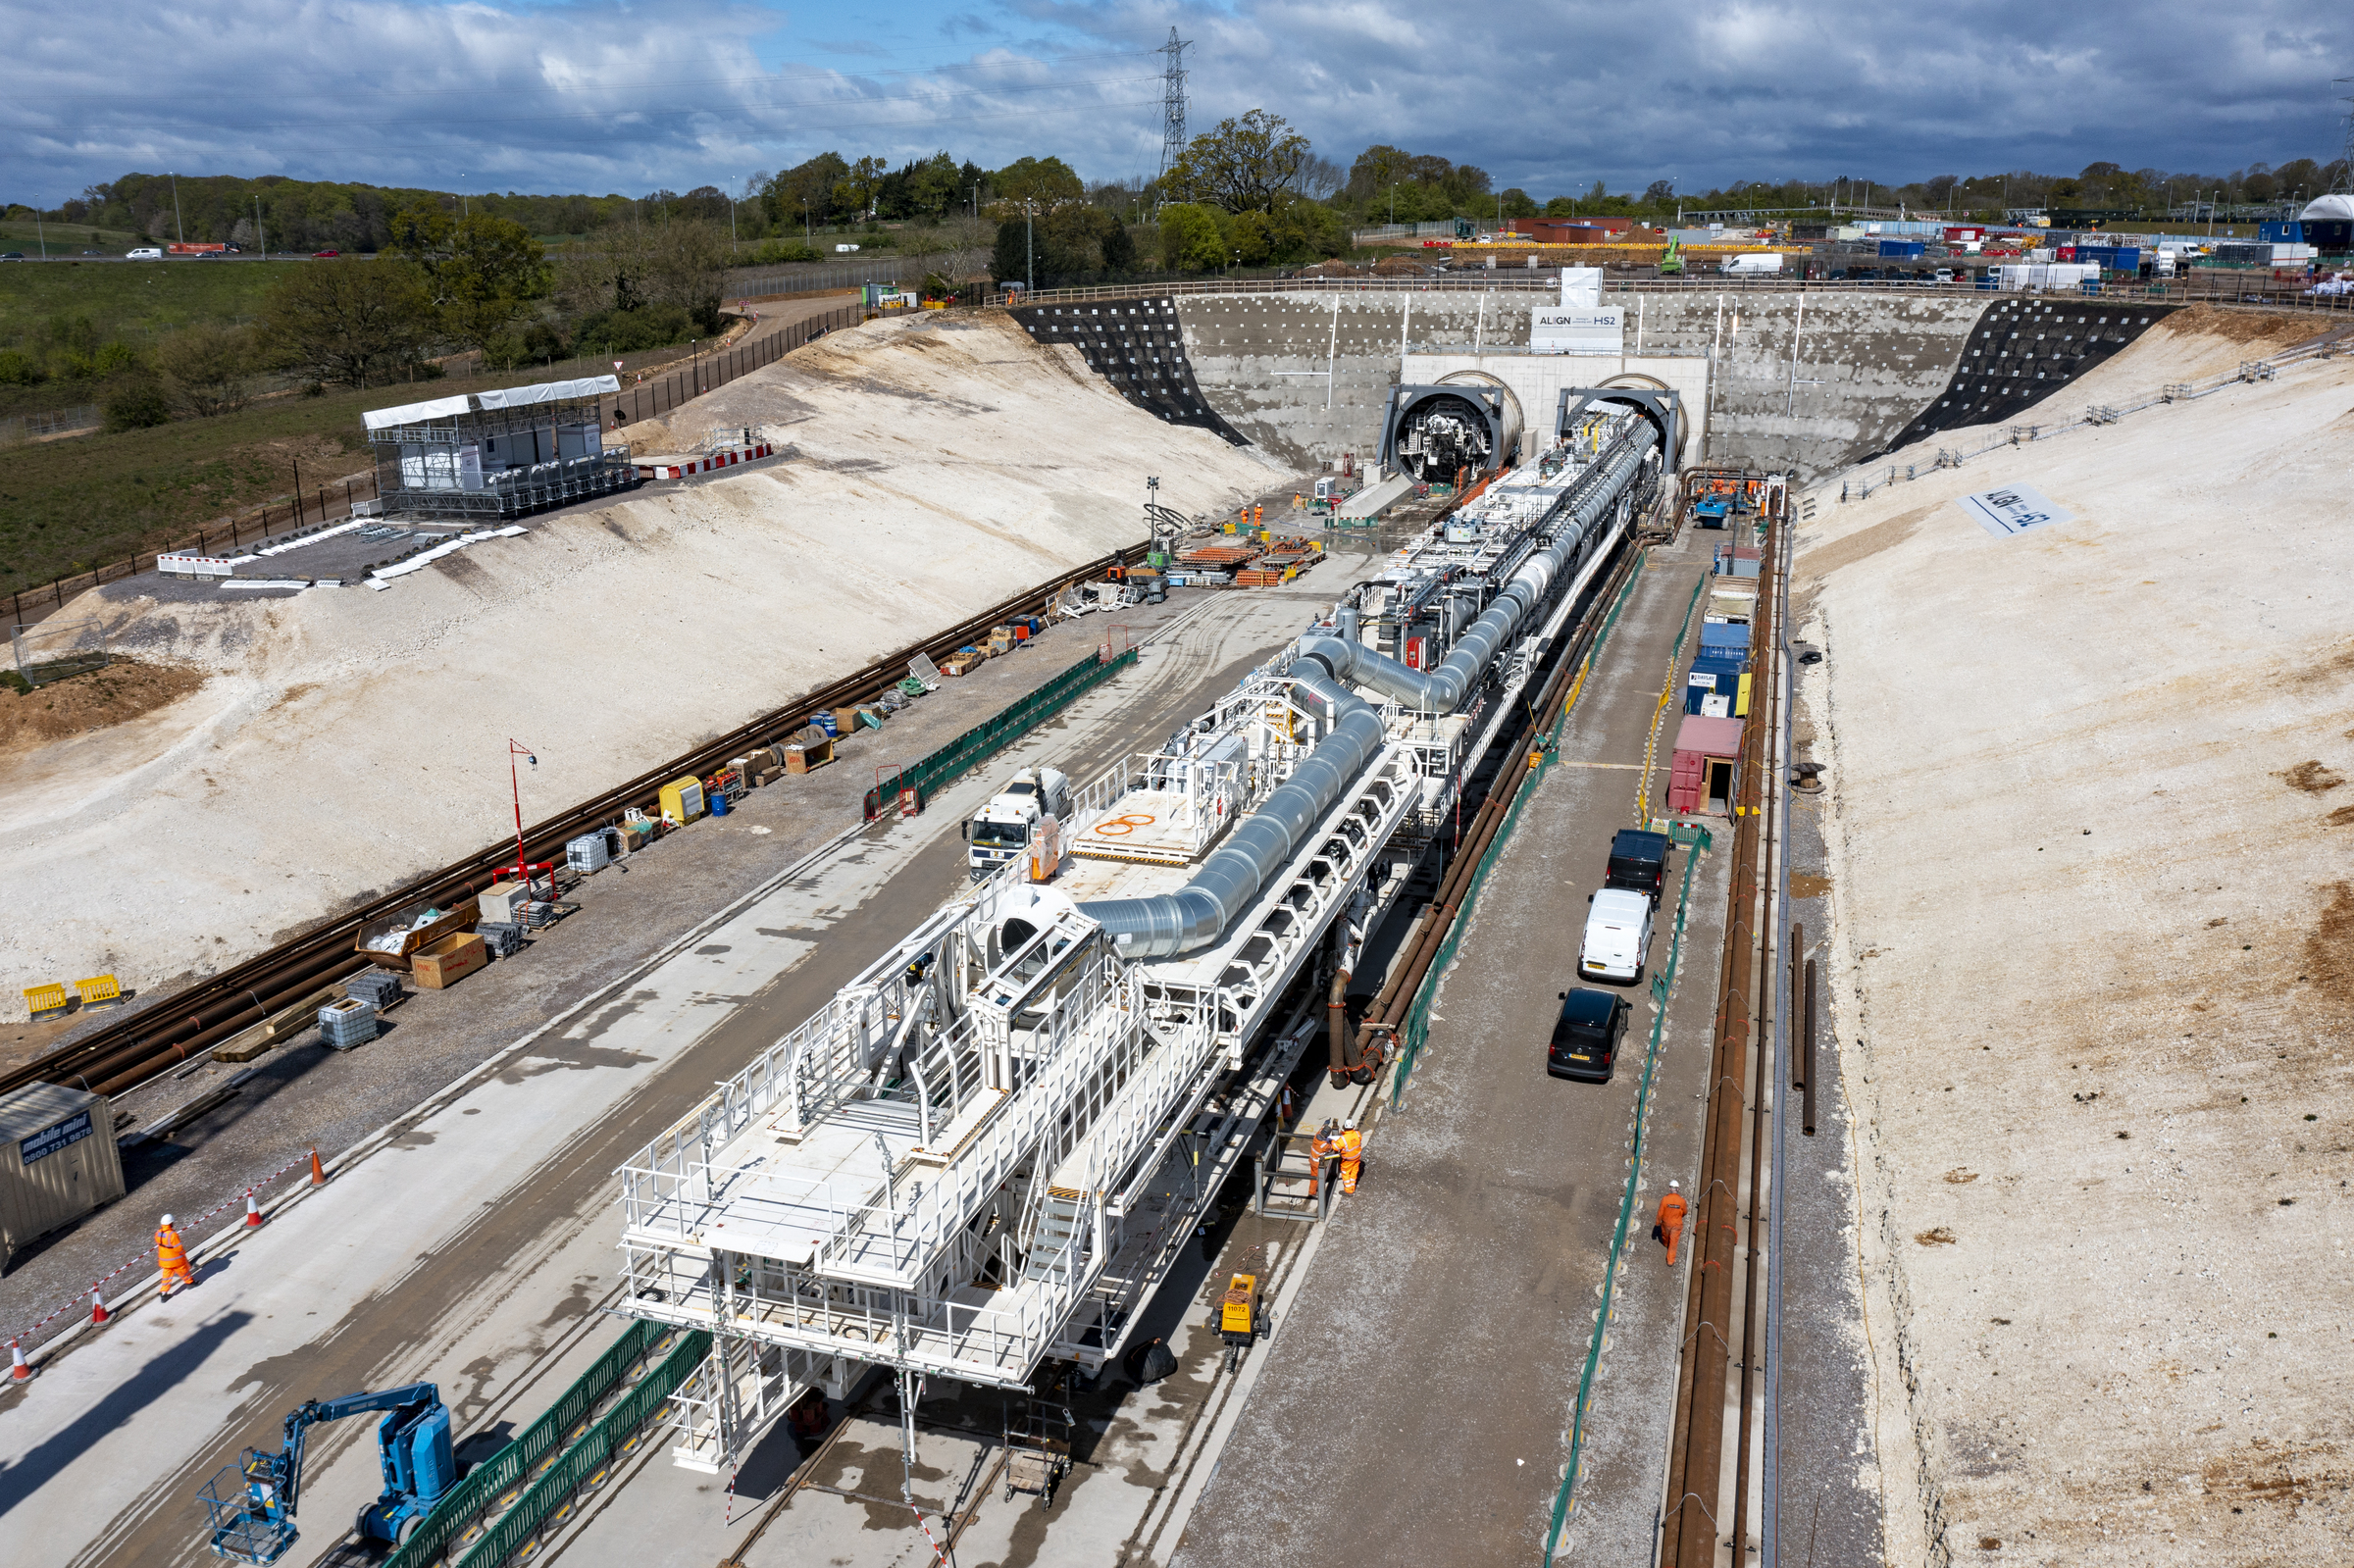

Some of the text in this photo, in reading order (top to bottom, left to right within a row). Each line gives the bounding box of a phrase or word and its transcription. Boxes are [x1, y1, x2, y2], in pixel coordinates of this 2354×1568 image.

[1983, 489, 2051, 528] ALIGN HS2
[23, 1113, 87, 1153] mobile mini
[24, 1127, 92, 1164] 0800 731 9878
